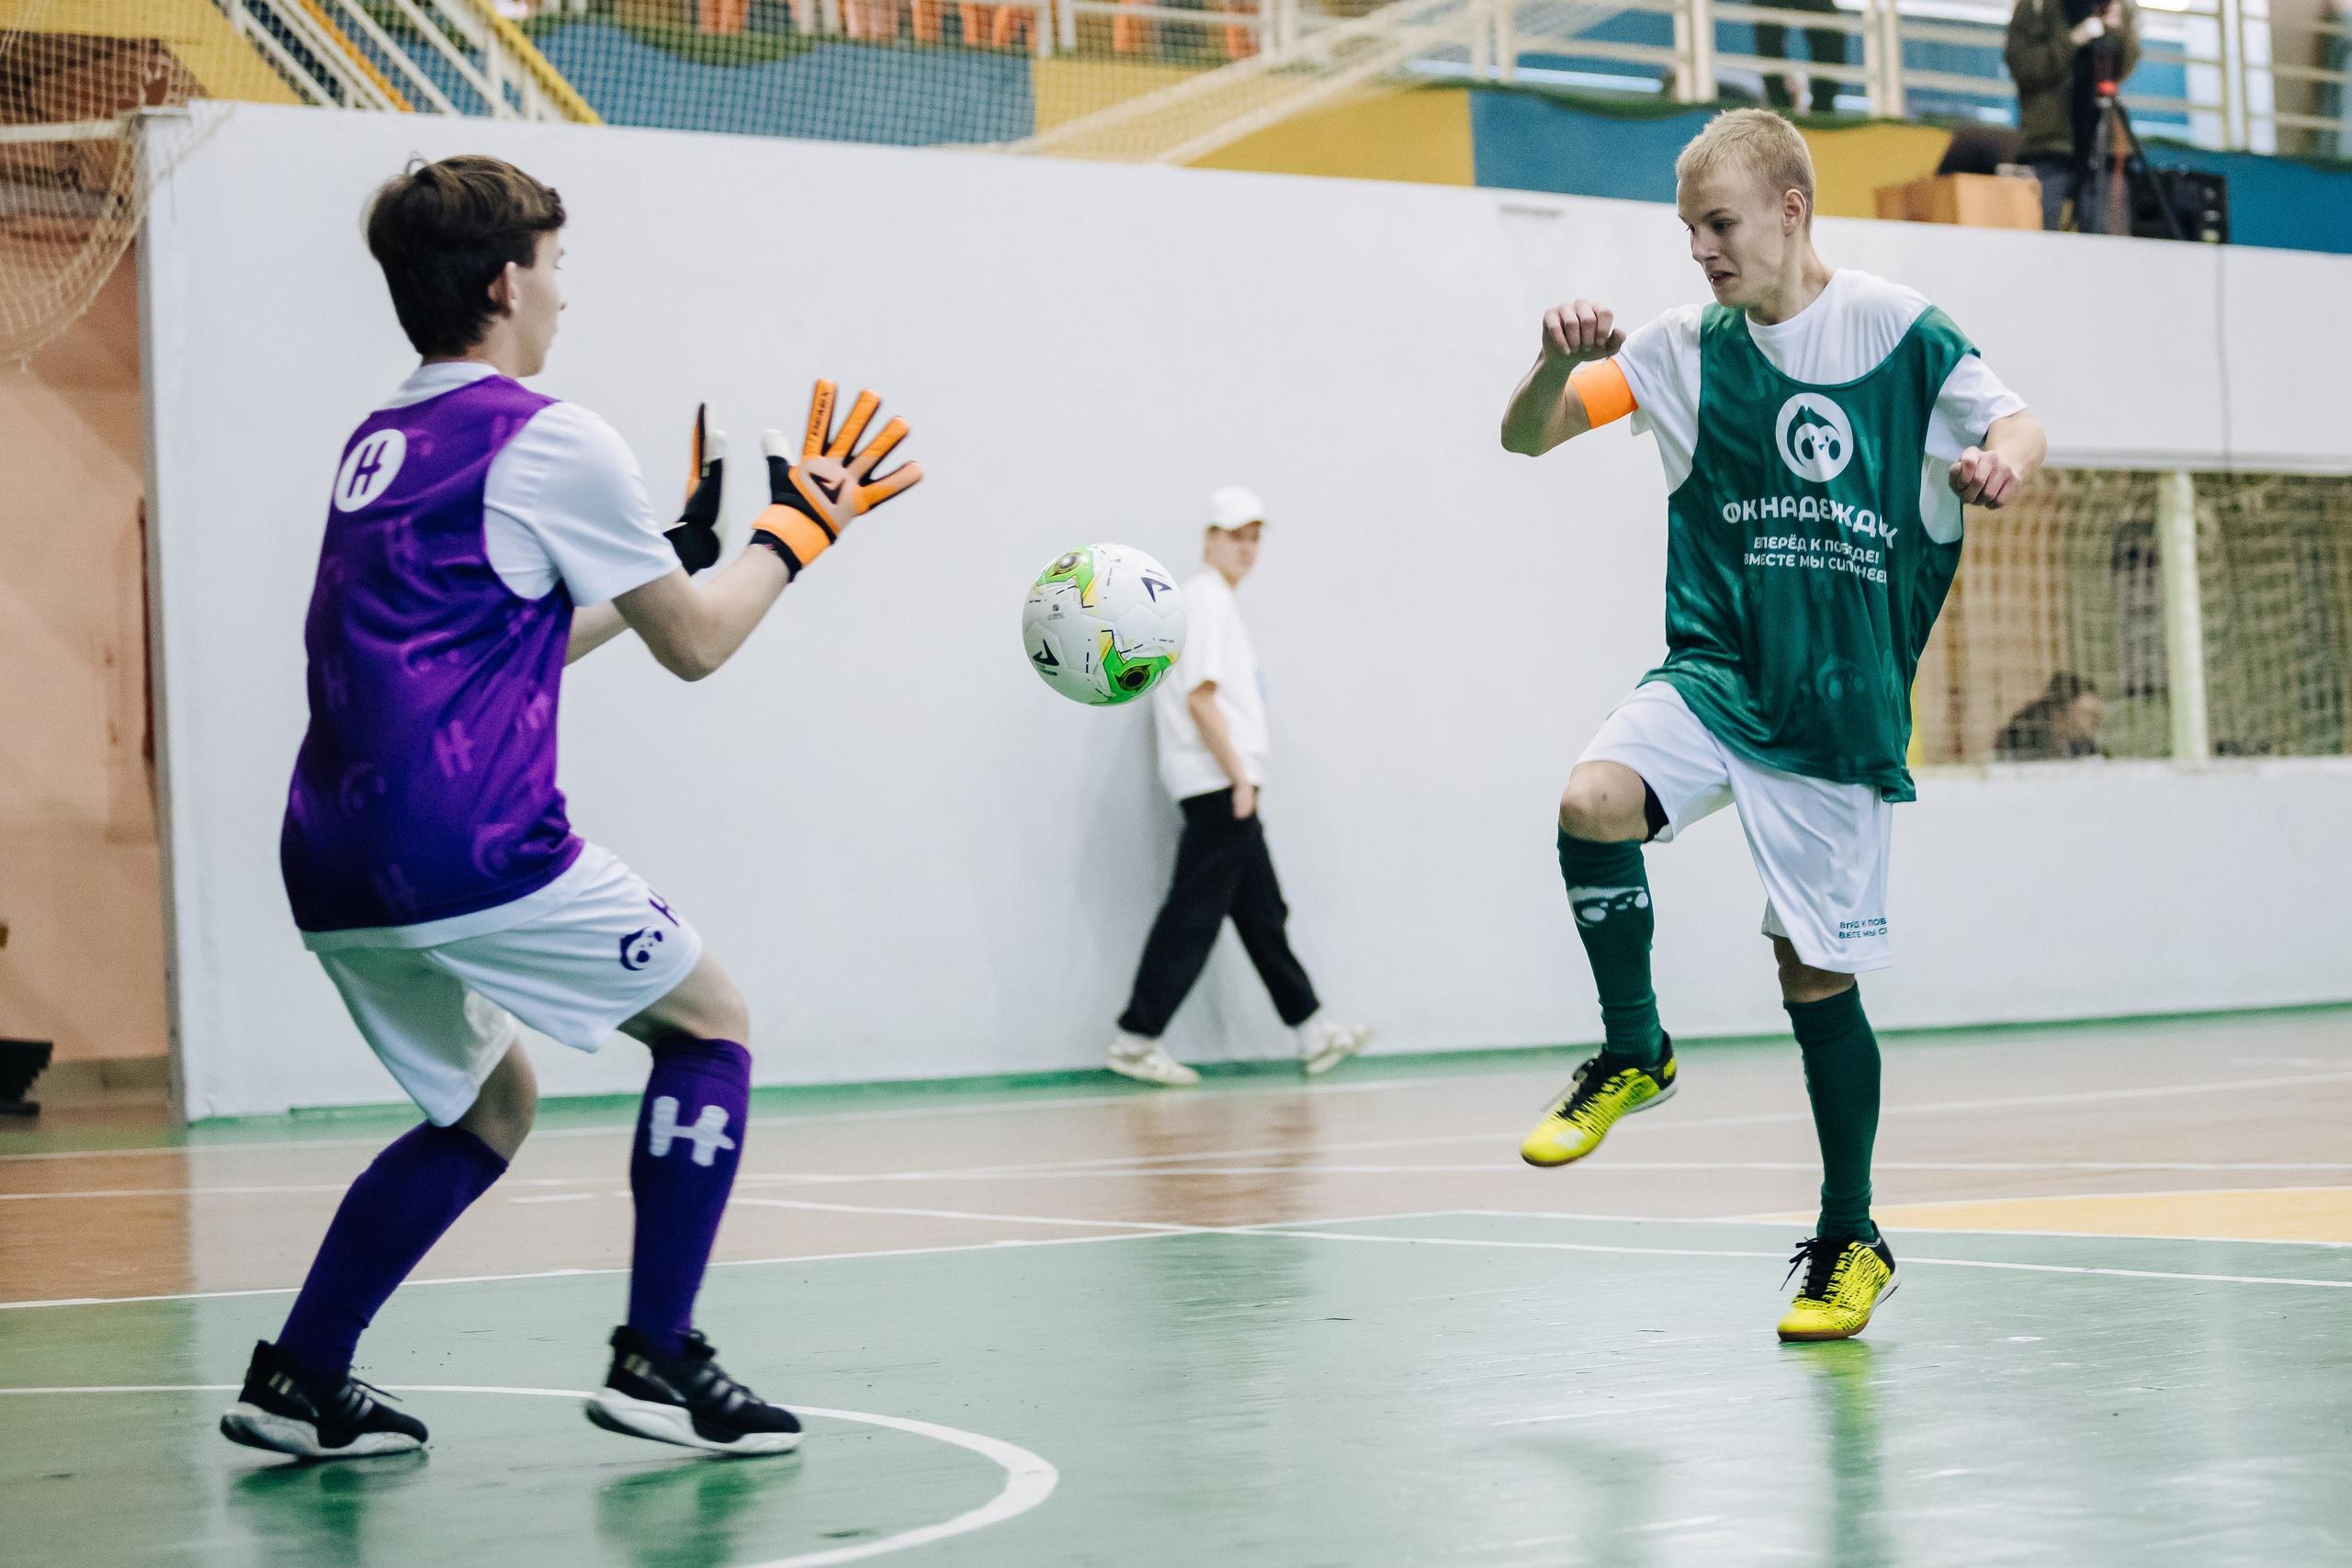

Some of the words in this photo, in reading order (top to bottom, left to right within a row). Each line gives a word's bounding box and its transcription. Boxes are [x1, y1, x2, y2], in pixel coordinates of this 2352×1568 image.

[1754, 534, 1807, 552] ВПЕРЁД
[1810, 537, 1822, 551] К
[1744, 553, 1796, 567] ВМЕСТЕ
[1800, 555, 1825, 569] МЫ
